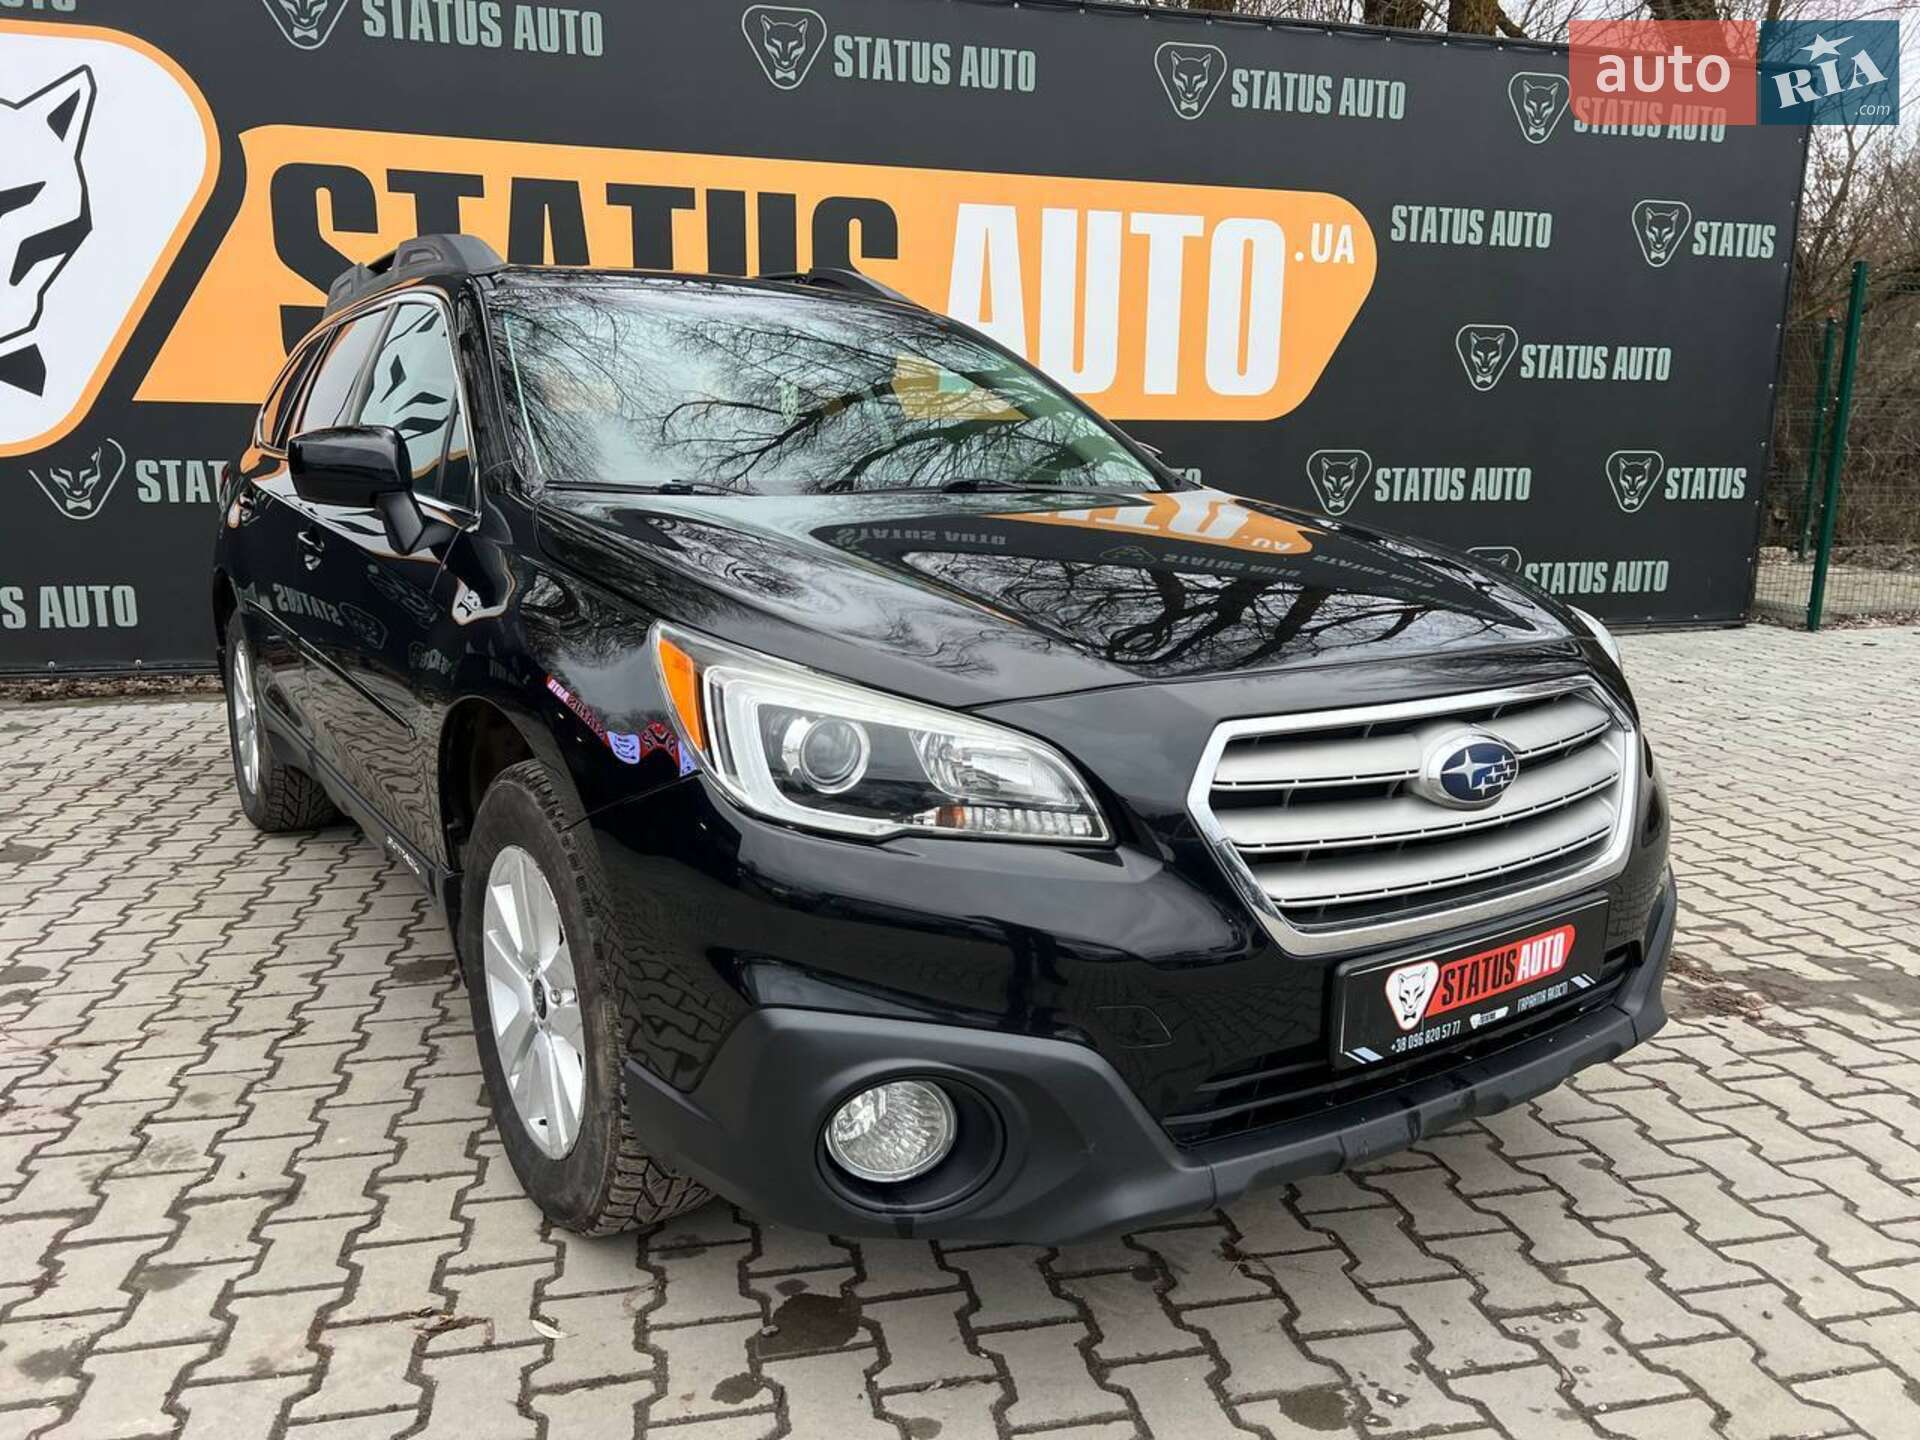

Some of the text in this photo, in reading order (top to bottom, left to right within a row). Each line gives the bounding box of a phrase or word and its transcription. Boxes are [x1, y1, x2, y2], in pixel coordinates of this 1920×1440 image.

[514, 5, 604, 56] AUTO
[834, 34, 1036, 92] STATUS AUTO
[1231, 68, 1406, 120] STATUS AUTO
[1390, 205, 1553, 248] STATUS AUTO
[1692, 220, 1777, 259] STATUS
[1520, 344, 1672, 381] STATUS AUTO
[1374, 467, 1532, 502] STATUS AUTO
[1664, 467, 1747, 500] STATUS
[1612, 560, 1670, 593] AUTO
[40, 585, 138, 629] AUTO
[1441, 931, 1566, 1006] STATUS AUTO
[1407, 1031, 1425, 1049] 096
[1425, 1026, 1441, 1044] 820
